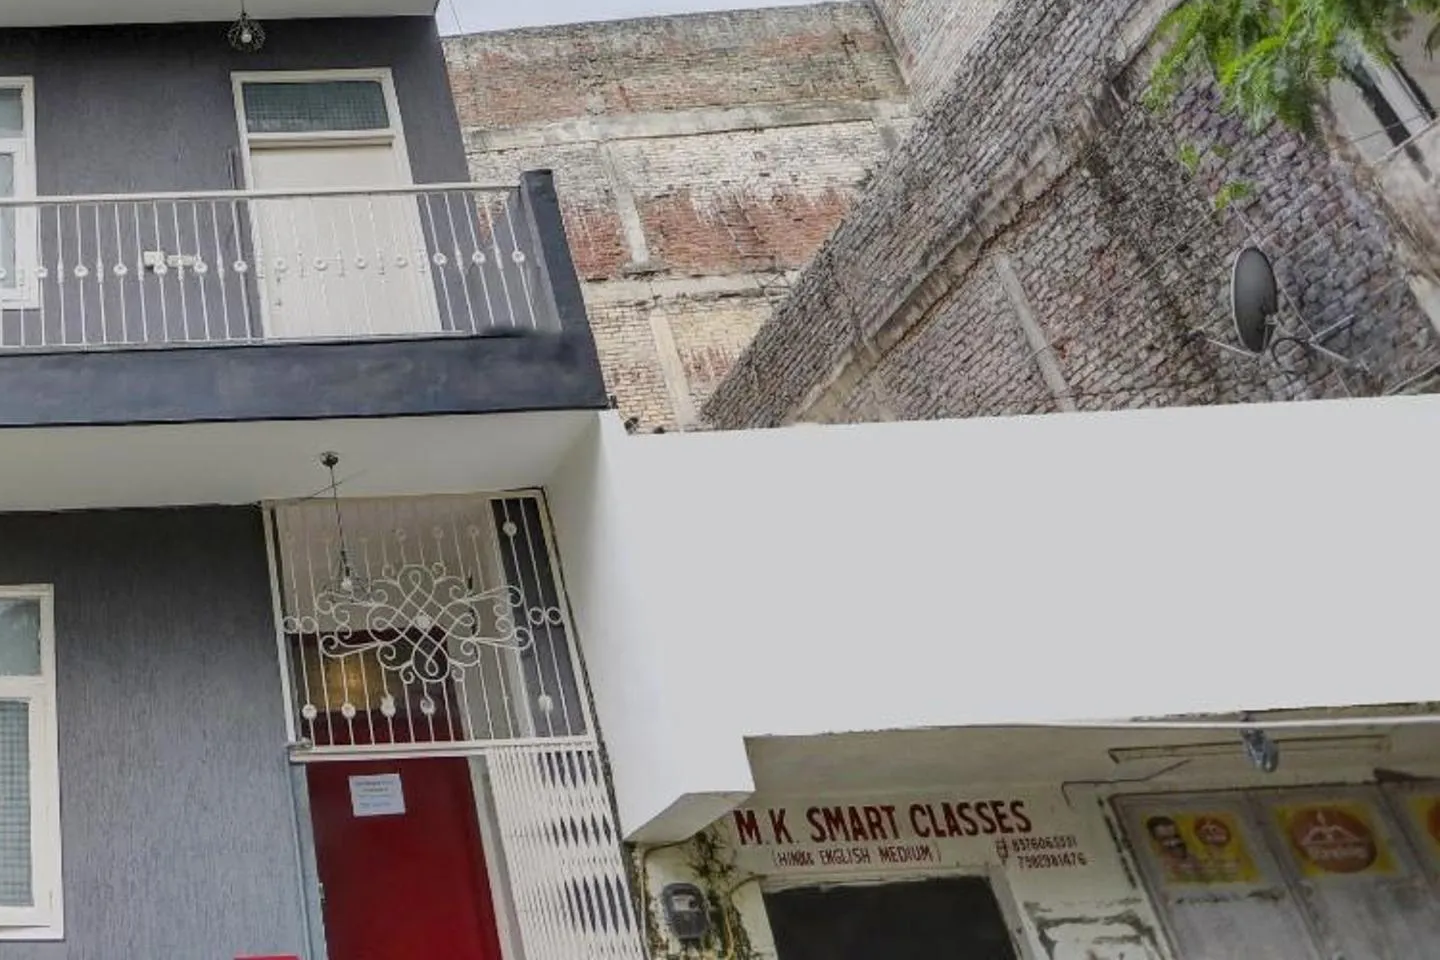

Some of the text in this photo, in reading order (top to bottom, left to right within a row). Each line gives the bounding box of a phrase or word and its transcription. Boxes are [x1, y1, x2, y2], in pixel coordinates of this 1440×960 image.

[806, 805, 901, 842] SMART
[909, 800, 1032, 838] CLASSES
[817, 847, 871, 866] ENGLISH
